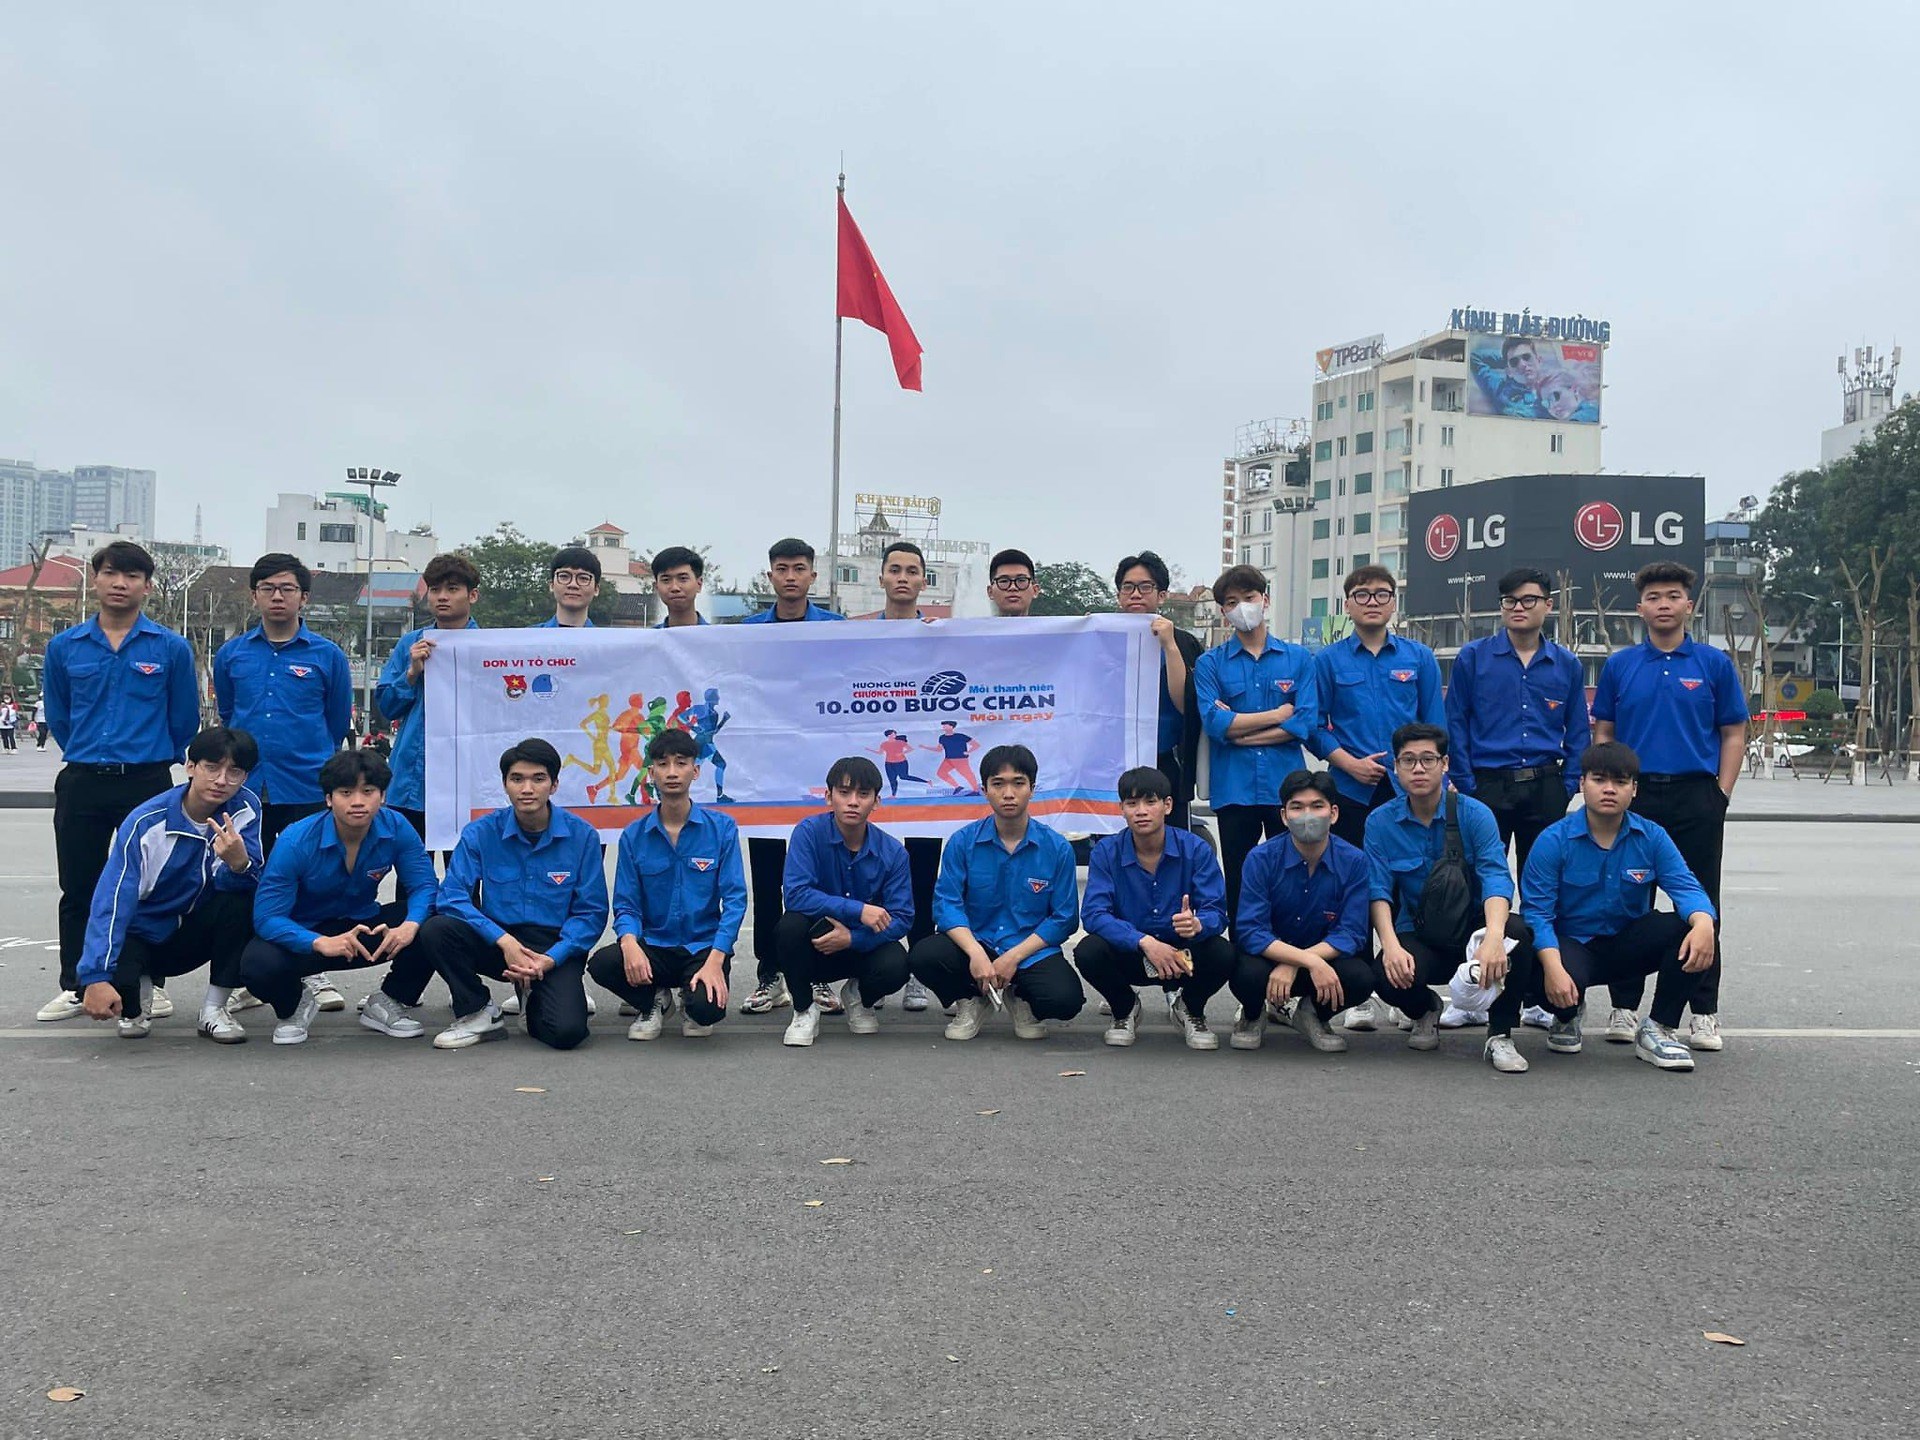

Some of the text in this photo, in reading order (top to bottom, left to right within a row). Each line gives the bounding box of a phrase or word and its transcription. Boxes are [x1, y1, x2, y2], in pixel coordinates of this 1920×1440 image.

[1451, 304, 1611, 344] KÍNH MẮT ĐƯỜNG
[1334, 339, 1382, 367] TPBank
[1465, 513, 1507, 551] LG
[1629, 510, 1685, 547] LG
[816, 700, 898, 715] 10.000
